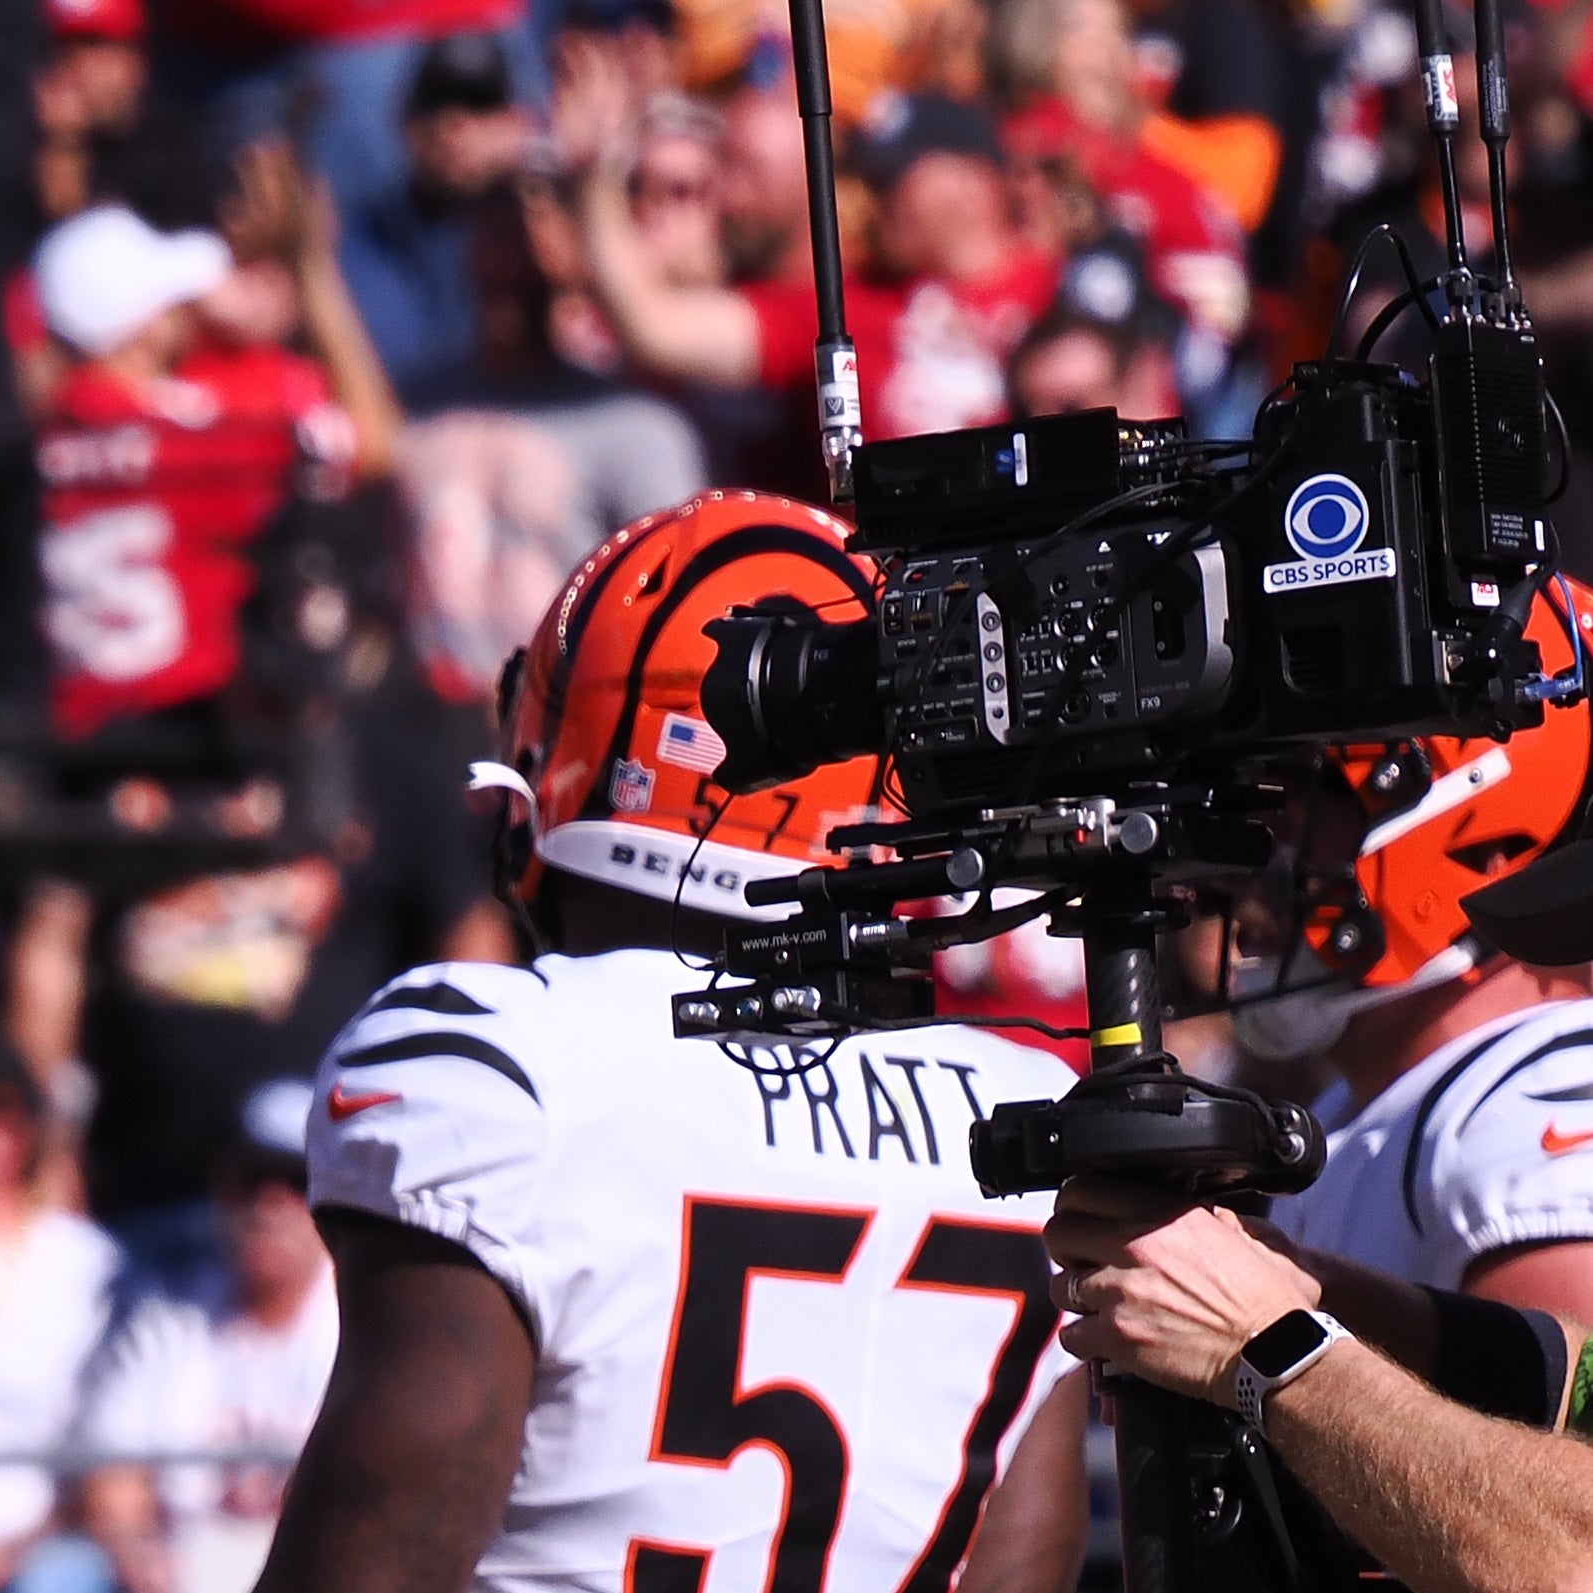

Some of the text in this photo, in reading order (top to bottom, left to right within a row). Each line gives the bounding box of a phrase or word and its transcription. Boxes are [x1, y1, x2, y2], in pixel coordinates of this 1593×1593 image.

[1270, 554, 1391, 586] CBS SPORTS
[1140, 696, 1161, 710] FX9
[688, 776, 801, 851] 57
[608, 841, 742, 893] BENG
[742, 928, 828, 951] www.mk-v.com
[745, 1043, 990, 1167] PRATT
